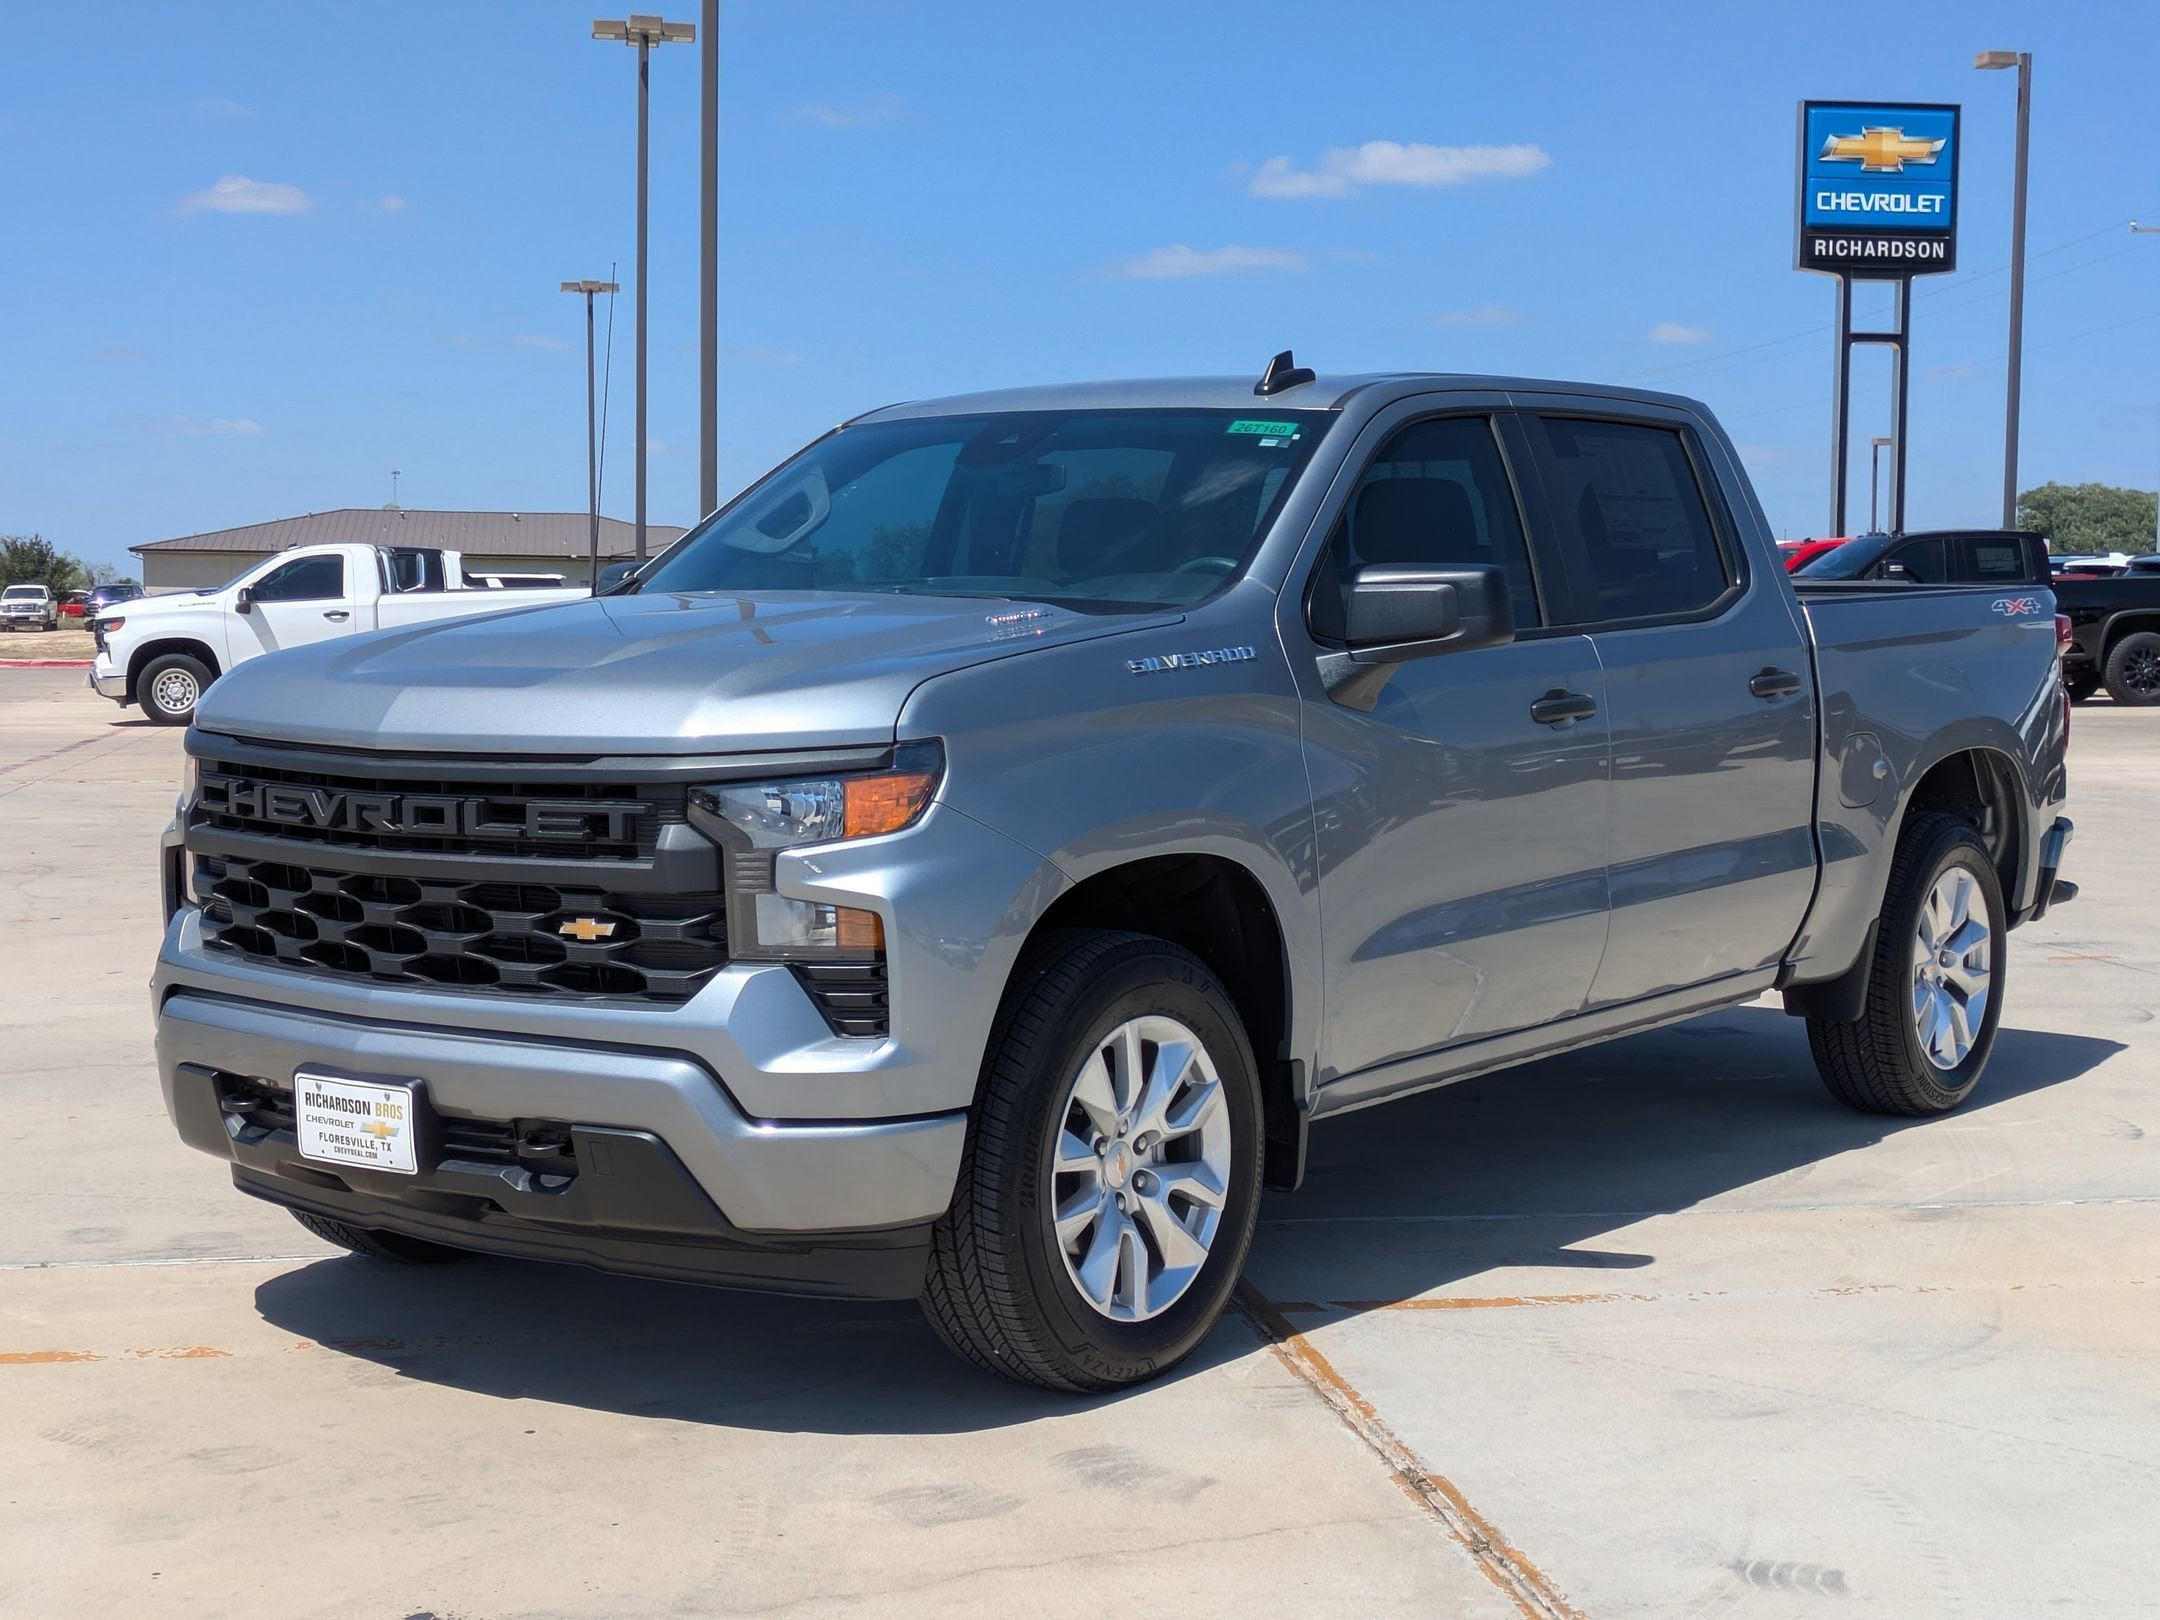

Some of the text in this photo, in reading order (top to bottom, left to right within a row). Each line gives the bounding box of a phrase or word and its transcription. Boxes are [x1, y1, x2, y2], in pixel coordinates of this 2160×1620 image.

[1817, 192, 1946, 213] CHEVROLET
[1814, 239, 1944, 259] RICHARDSON
[1234, 423, 1287, 434] 26T160
[1128, 646, 1257, 674] SILVERADO
[199, 772, 658, 841] CHEVROLET
[305, 1092, 403, 1120] RICHARDSON BROS
[306, 1114, 355, 1129] CHEVROLET
[319, 1132, 392, 1152] FLORESVILLE, TX
